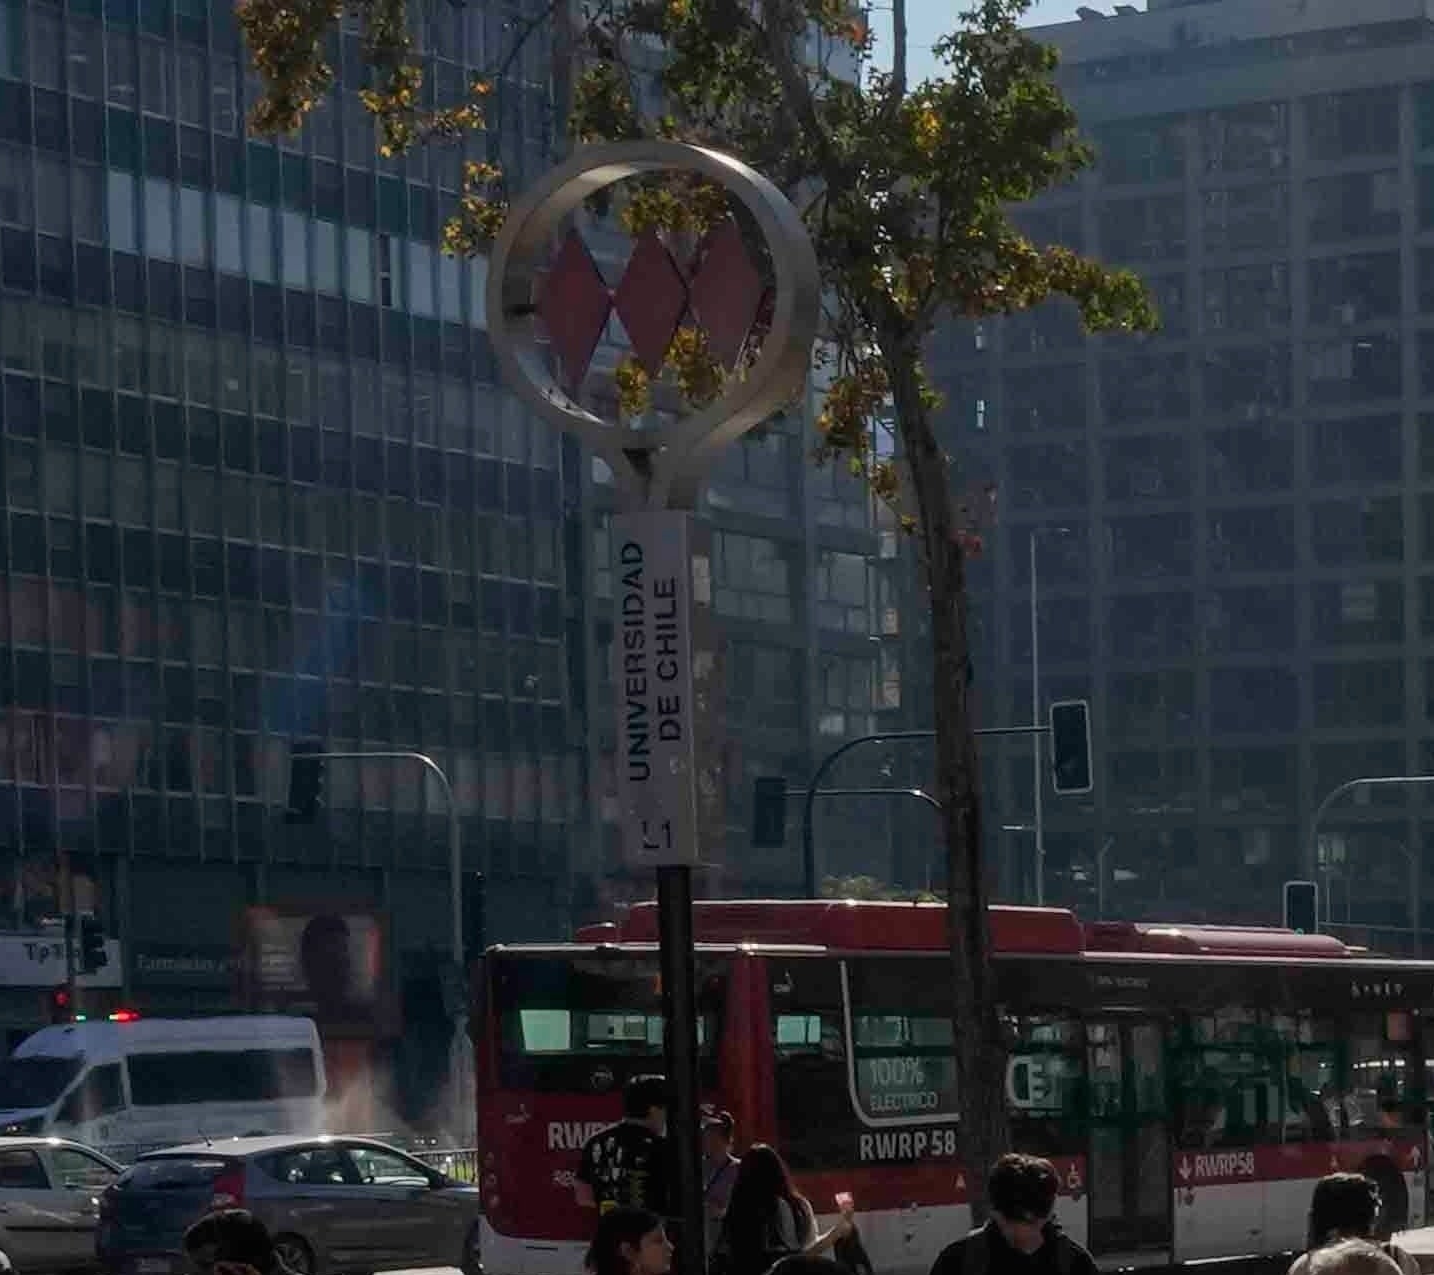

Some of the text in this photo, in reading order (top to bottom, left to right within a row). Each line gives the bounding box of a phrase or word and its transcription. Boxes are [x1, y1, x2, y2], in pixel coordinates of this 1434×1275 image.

[621, 541, 651, 781] UNIVERSIDAD
[654, 577, 682, 740] DE CHILE
[869, 1056, 926, 1086] 100%
[859, 1129, 957, 1161] RWRP 58
